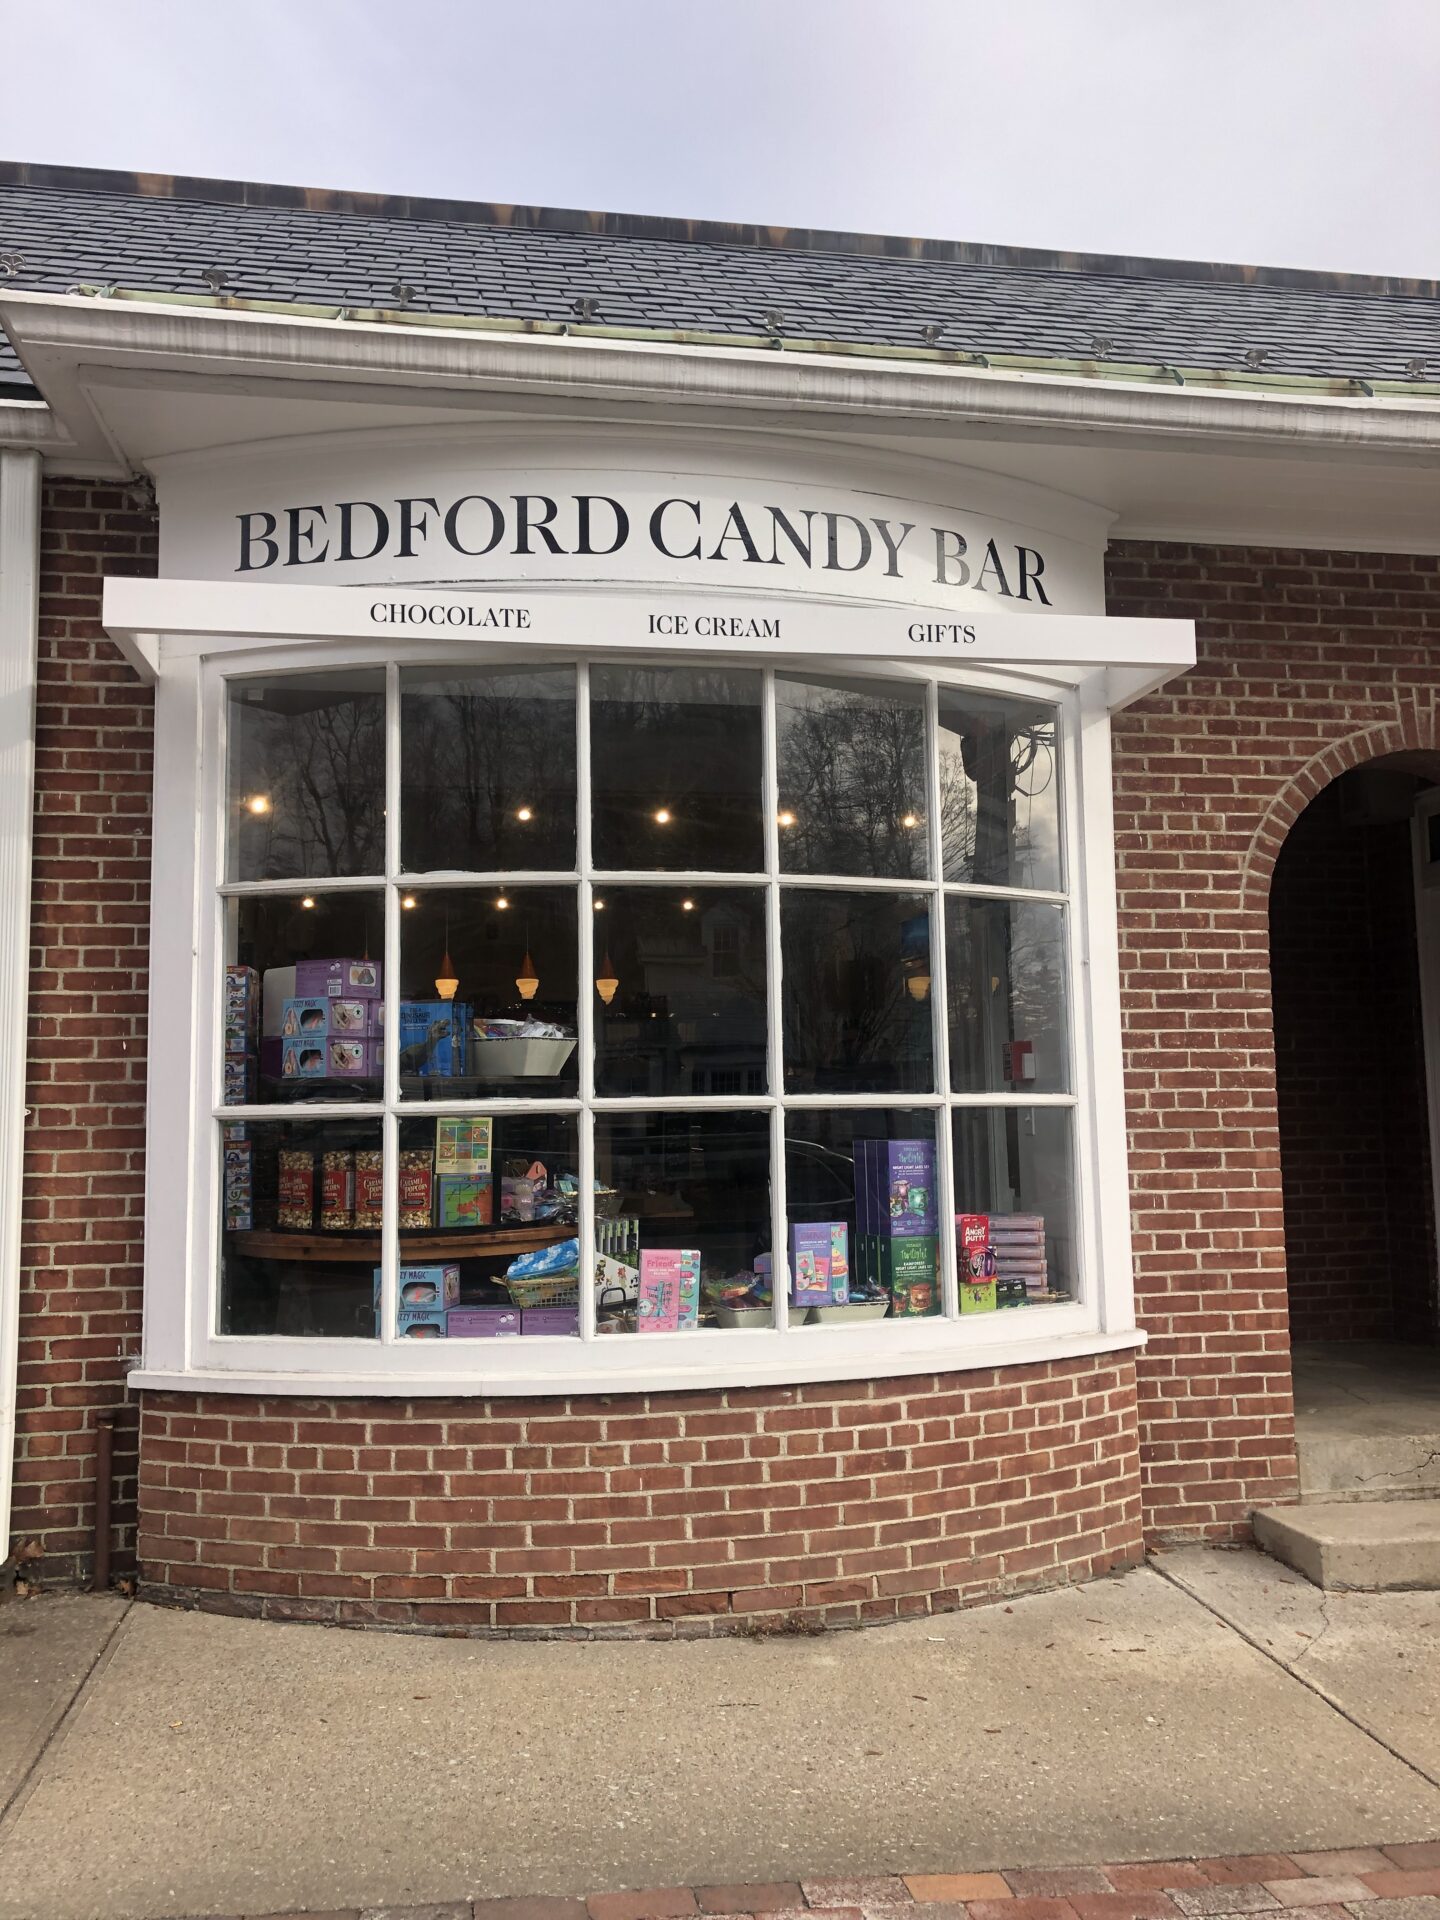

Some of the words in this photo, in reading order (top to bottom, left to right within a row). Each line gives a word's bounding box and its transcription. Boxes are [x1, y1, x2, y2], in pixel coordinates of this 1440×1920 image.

[233, 494, 631, 573] BEDFORD
[649, 497, 917, 579] CANDY
[929, 526, 1054, 607] BAR
[370, 602, 531, 629] CHOCOLATE
[648, 613, 687, 635] ICE
[692, 615, 782, 639] CREAM
[907, 623, 978, 644] GIFTS
[964, 1226, 986, 1237] ANGRY
[965, 1235, 986, 1246] PUTTY
